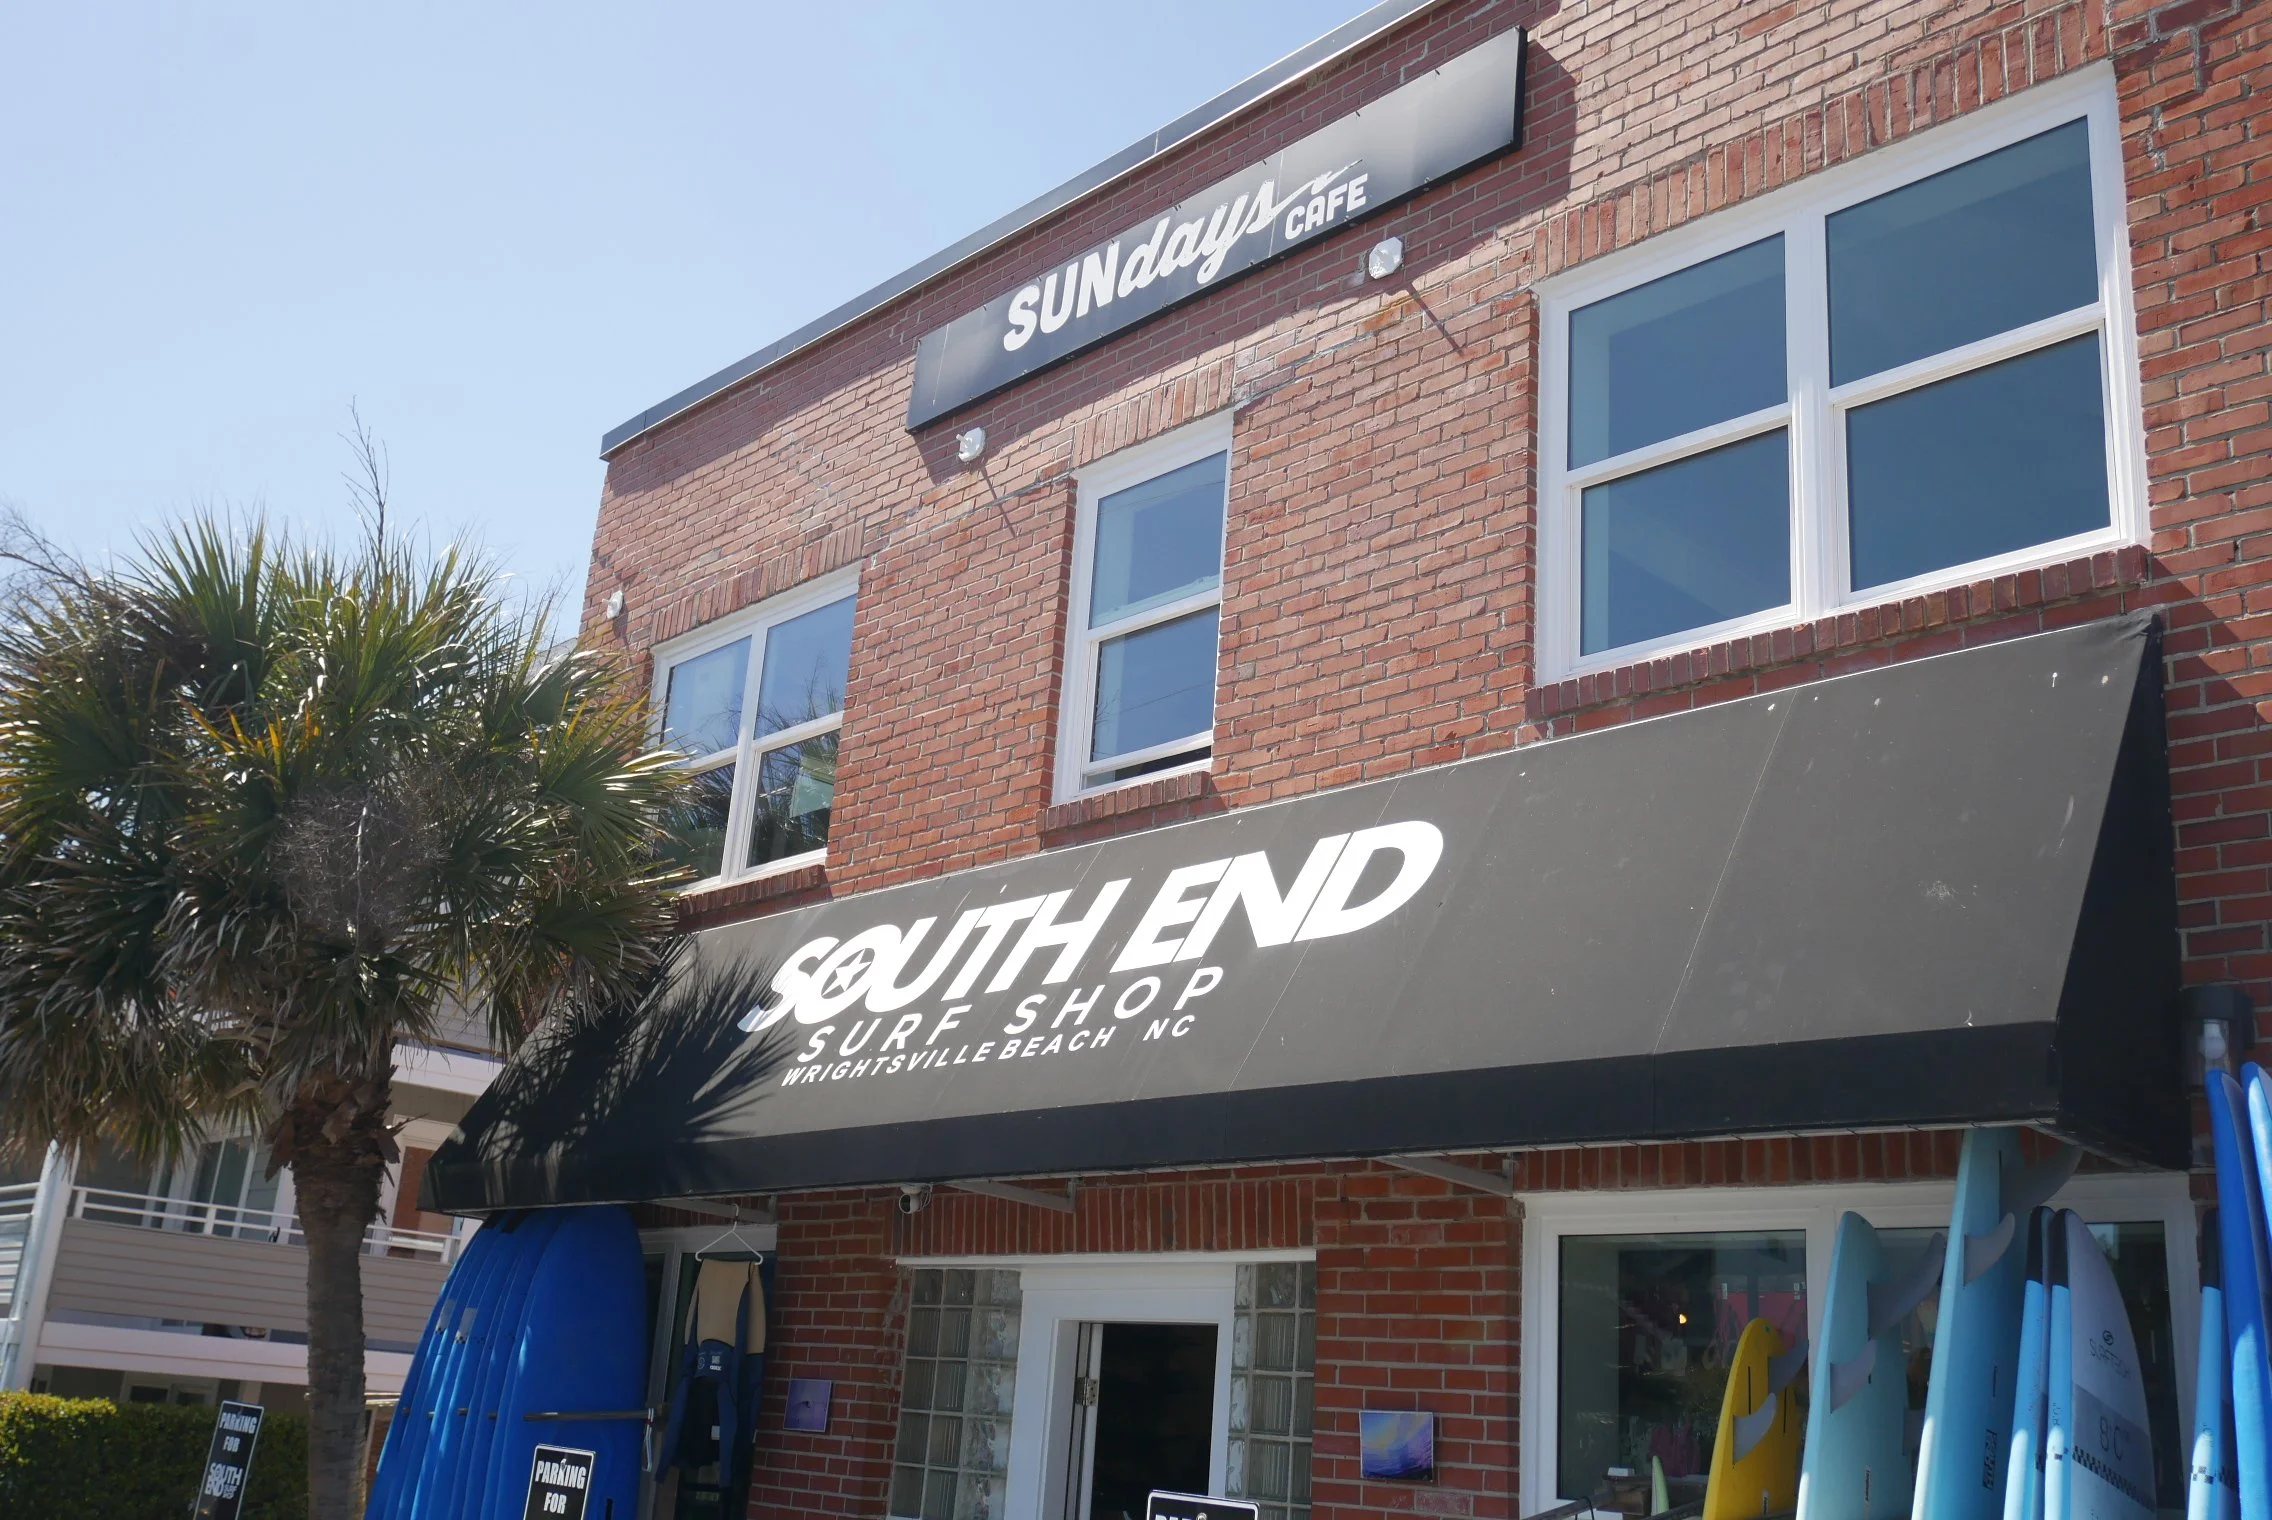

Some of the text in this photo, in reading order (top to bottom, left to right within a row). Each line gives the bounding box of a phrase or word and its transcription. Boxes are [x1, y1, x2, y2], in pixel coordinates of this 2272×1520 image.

[1285, 173, 1368, 240] CAFE
[1004, 168, 1320, 351] SUNdays
[737, 820, 1444, 1032] SOUTH END
[797, 966, 1223, 1063] SURF SHOP
[781, 1014, 1196, 1087] WRIGHTSVILLE BEACH NC
[219, 1412, 258, 1434] PARKING
[222, 1435, 241, 1453] FOR
[210, 1462, 243, 1486] SOUTH
[535, 1460, 587, 1489] PARKING
[543, 1491, 568, 1514] FOR
